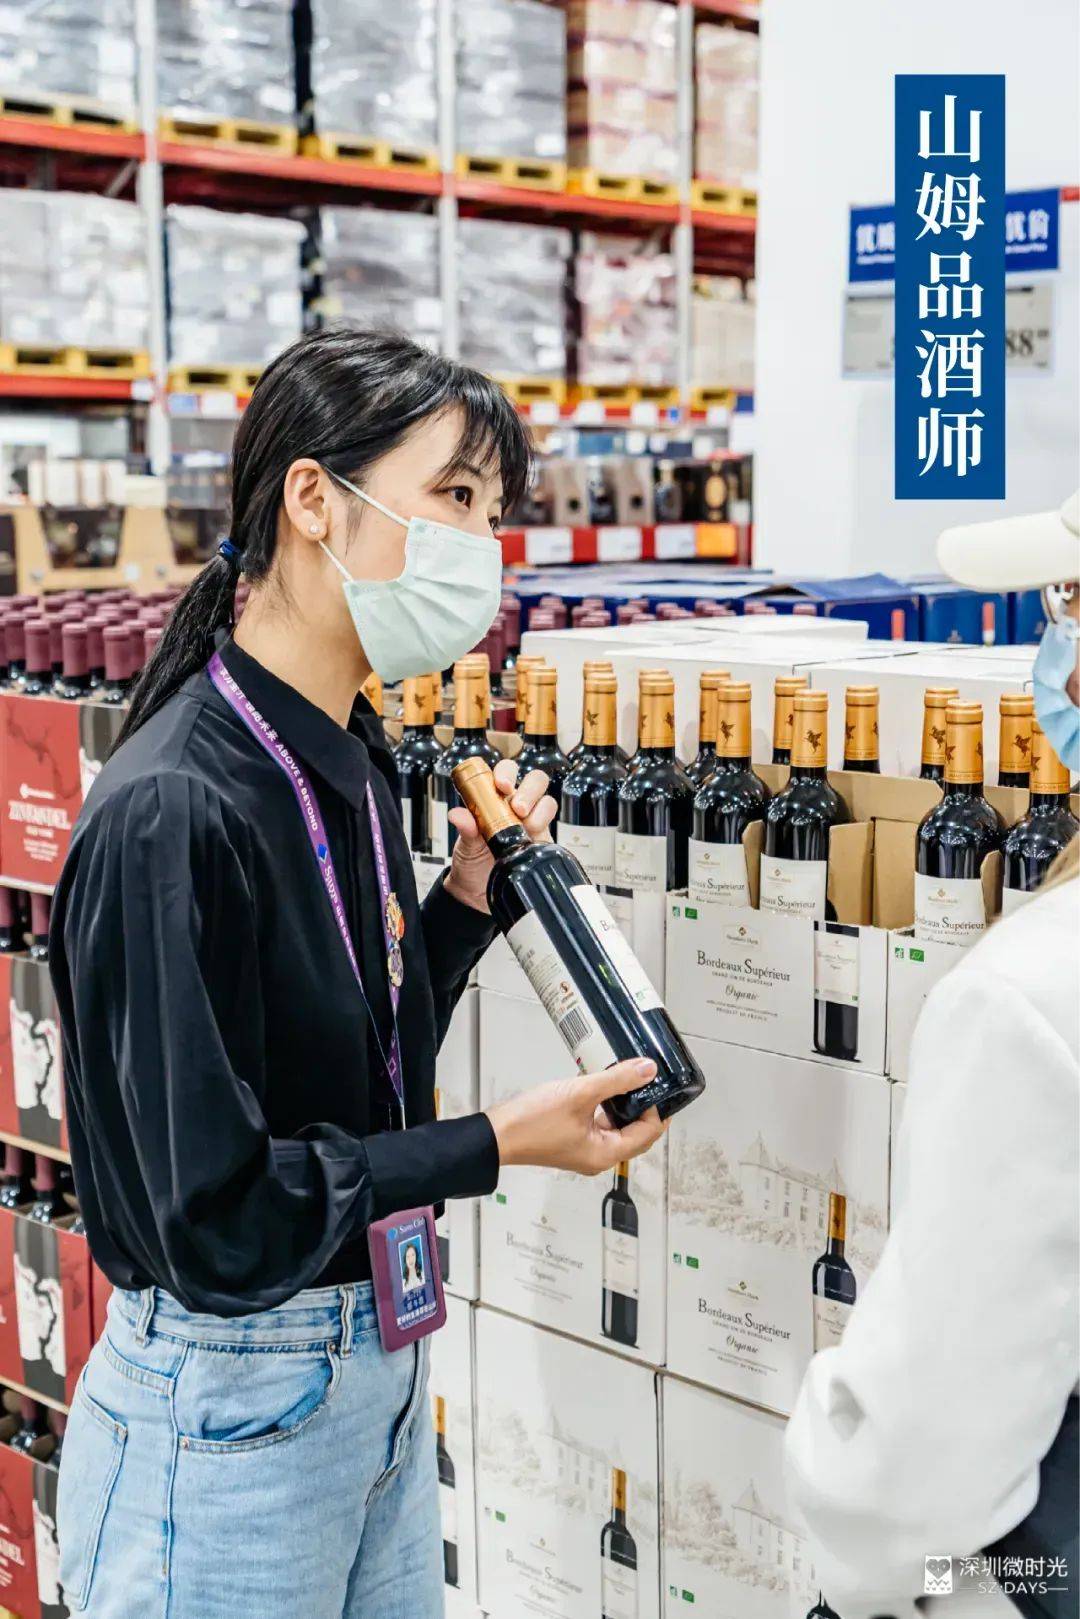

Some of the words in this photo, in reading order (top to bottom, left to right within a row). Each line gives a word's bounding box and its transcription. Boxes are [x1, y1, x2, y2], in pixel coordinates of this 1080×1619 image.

[276, 743, 302, 778] ABOVE
[300, 787, 318, 833] BEYOND
[942, 916, 984, 931] Supérieur
[697, 949, 742, 973] Bordeaux
[744, 959, 791, 981] Supérieur
[698, 1298, 743, 1325] Bordeaux
[744, 1312, 791, 1340] Supérieur
